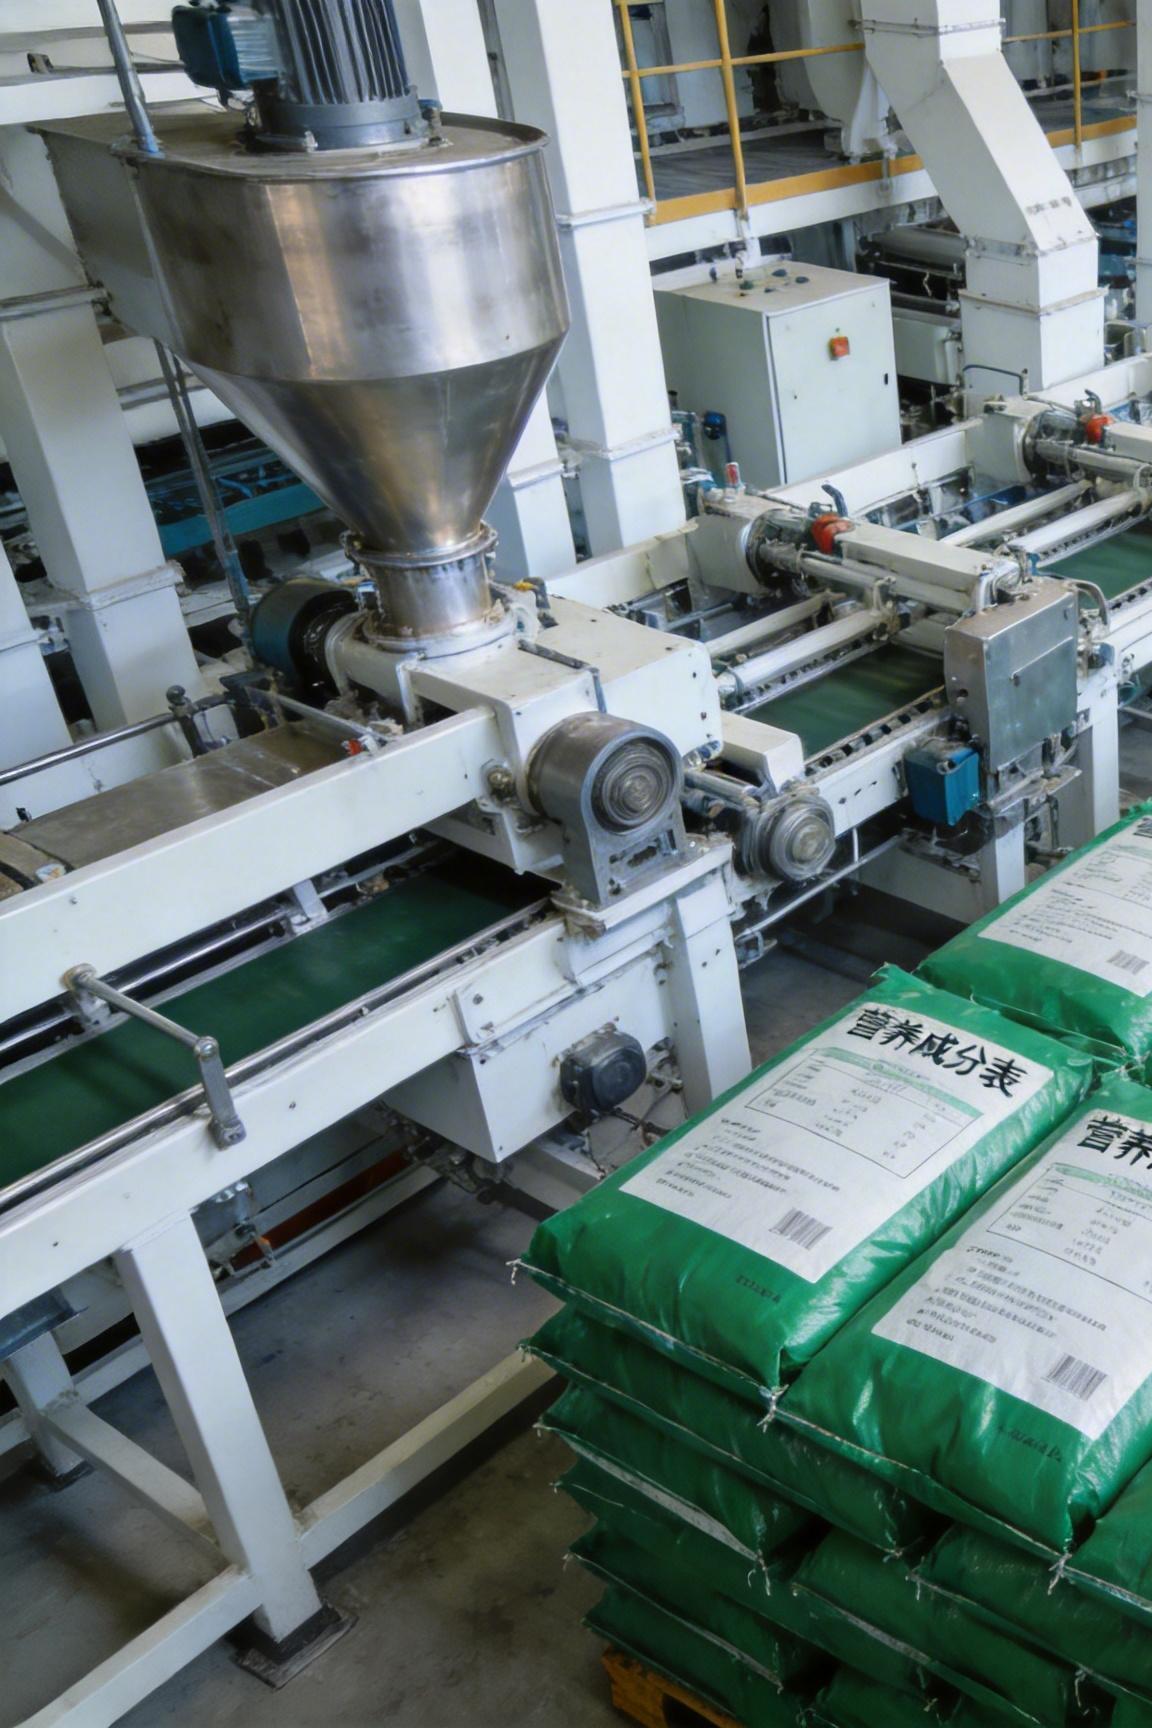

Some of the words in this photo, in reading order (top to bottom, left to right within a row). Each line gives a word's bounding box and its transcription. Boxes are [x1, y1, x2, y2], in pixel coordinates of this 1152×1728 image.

[846, 1006, 1028, 1098] 营养成分表
